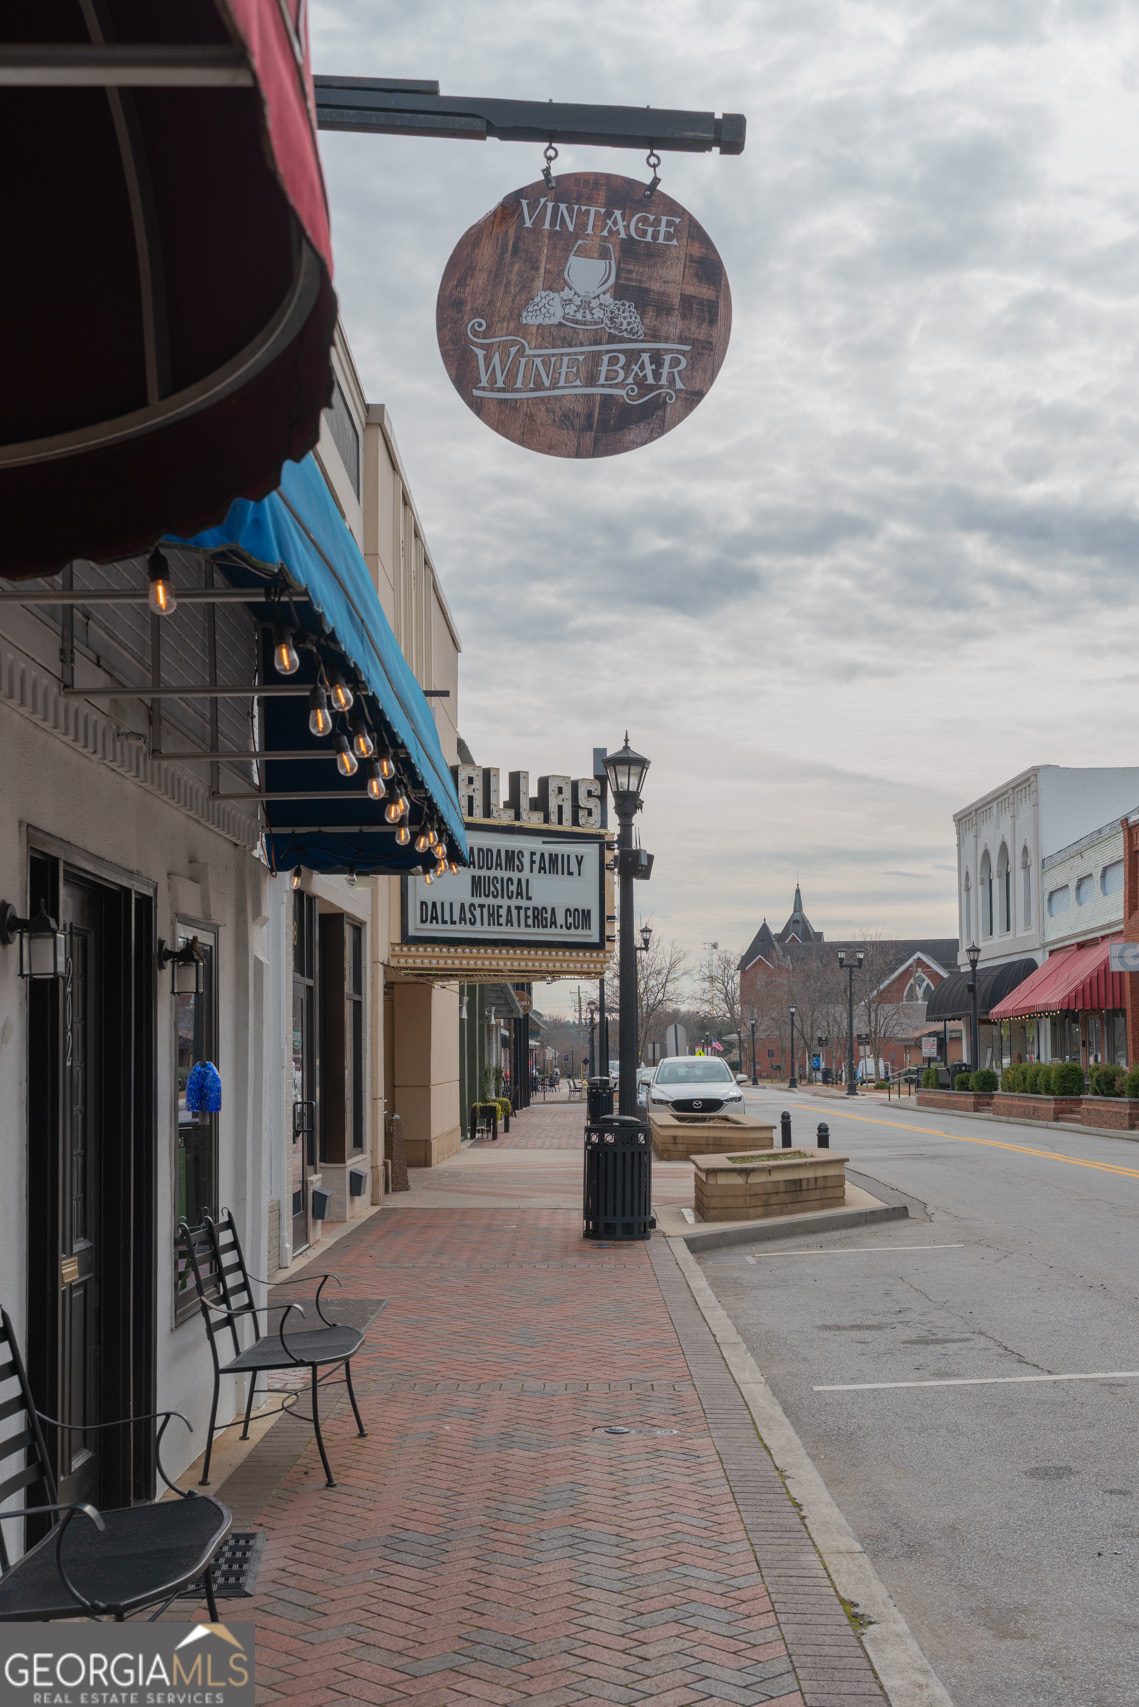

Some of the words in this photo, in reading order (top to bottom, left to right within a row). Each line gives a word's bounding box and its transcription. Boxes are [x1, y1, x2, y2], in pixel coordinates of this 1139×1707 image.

[519, 197, 682, 246] VINTAGE
[468, 344, 586, 388] WINE
[596, 352, 688, 390] BAR
[454, 764, 601, 829] ALLAS
[468, 846, 525, 873] ADDAMS
[529, 851, 585, 876] FAMILY
[470, 875, 533, 901] MUSICAL
[419, 900, 592, 931] DALLASTHEATERGA.COM
